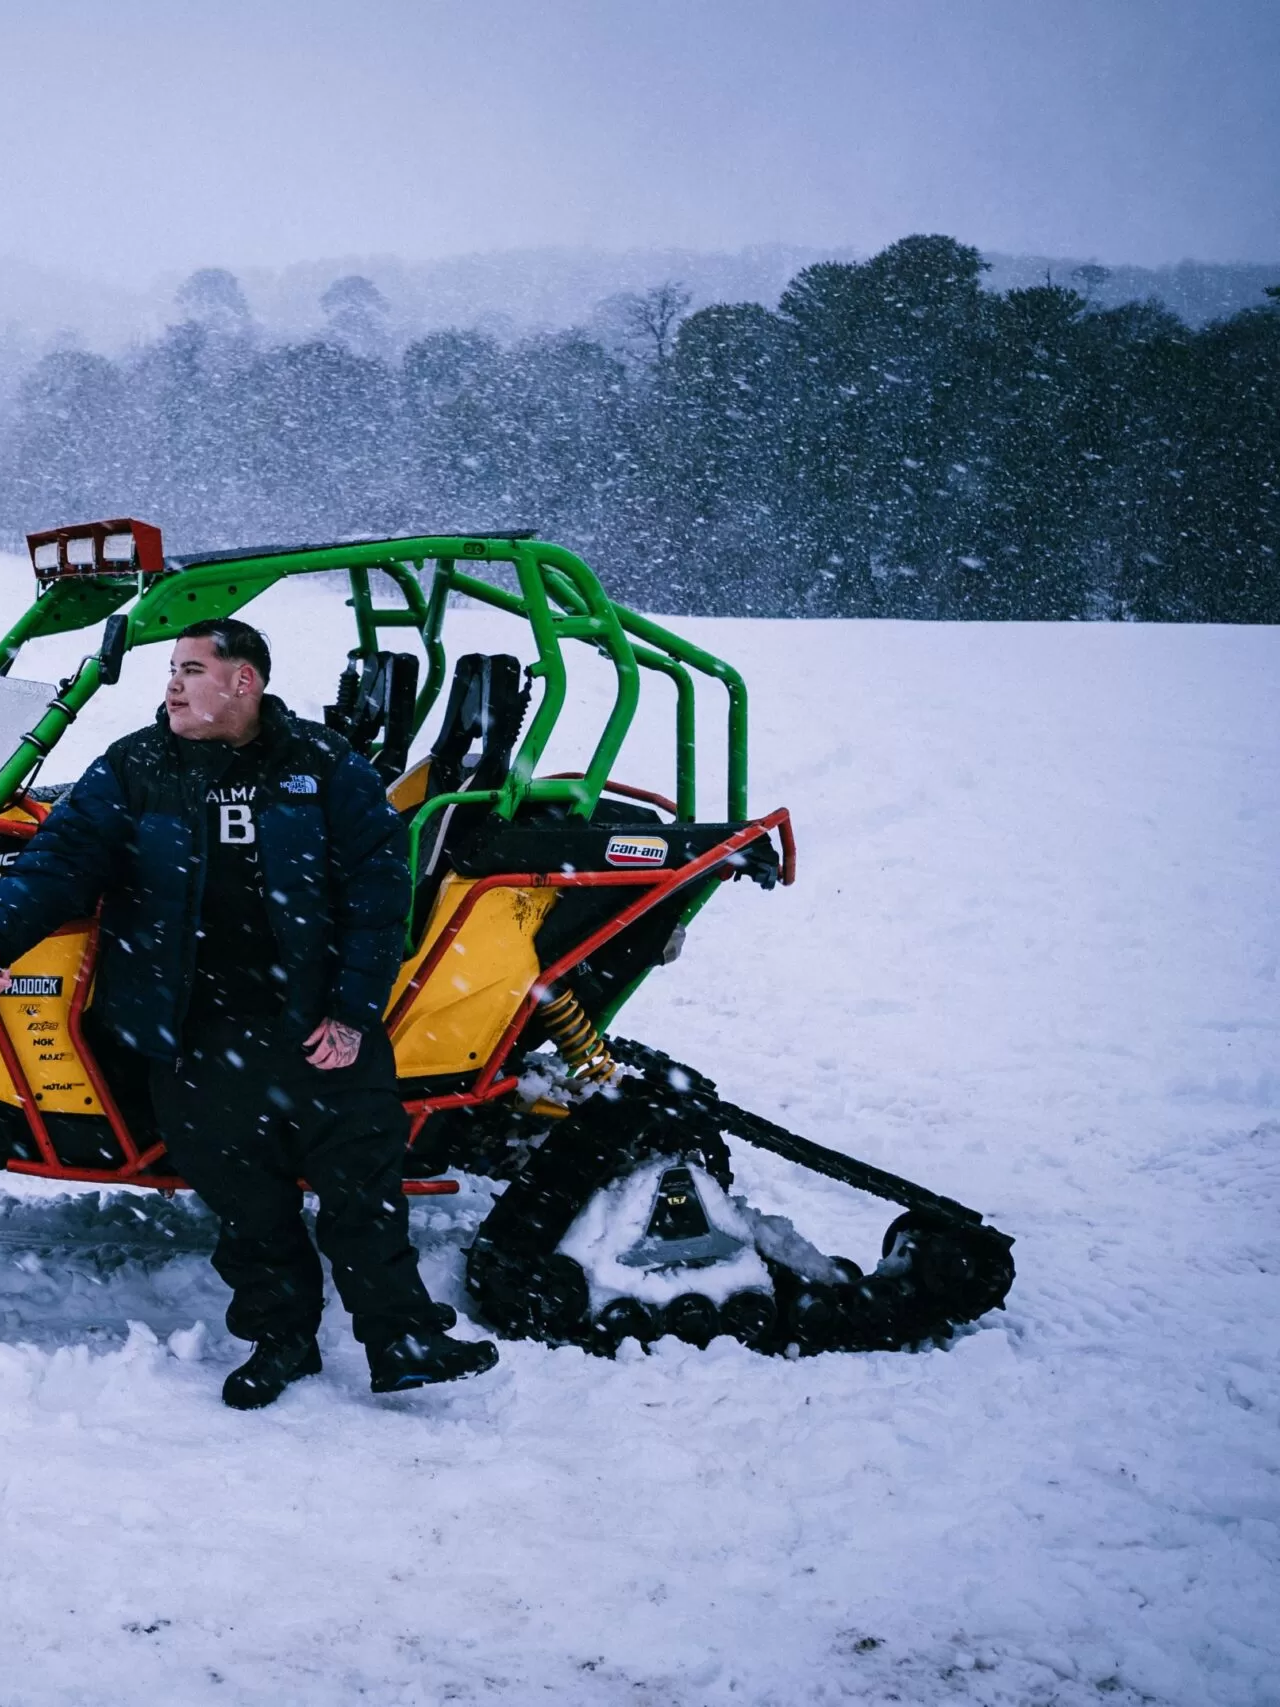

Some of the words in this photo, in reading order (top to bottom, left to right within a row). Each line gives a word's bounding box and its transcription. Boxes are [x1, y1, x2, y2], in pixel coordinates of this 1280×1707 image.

[220, 804, 256, 844] B
[610, 843, 664, 858] can-am
[33, 1038, 55, 1046] NGK
